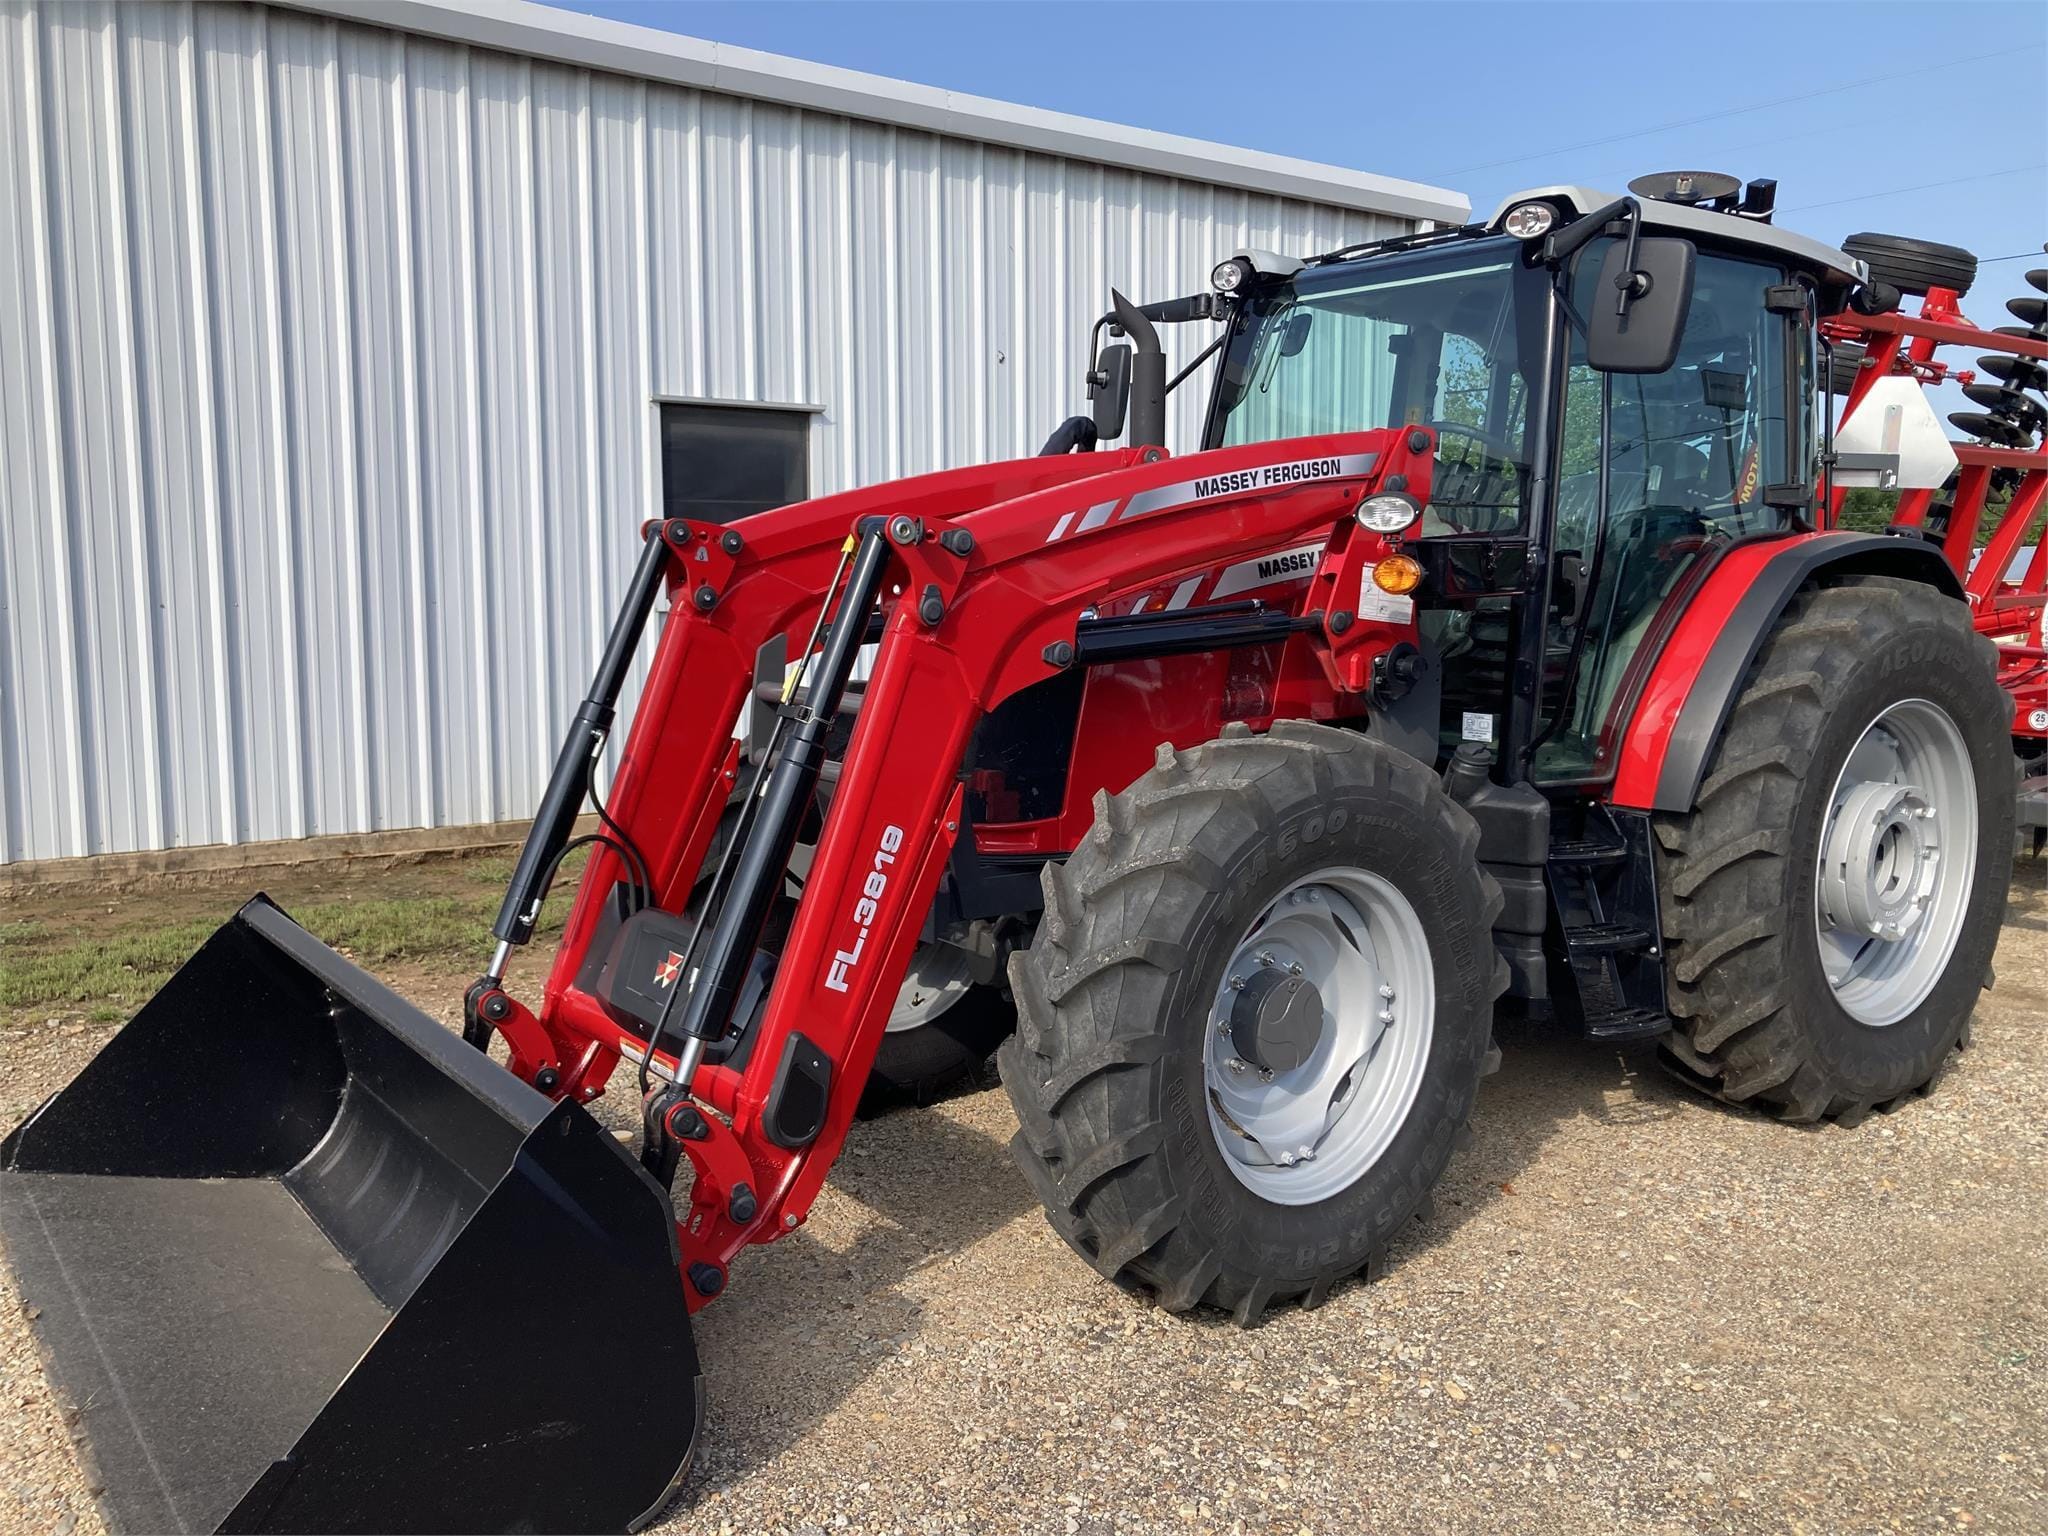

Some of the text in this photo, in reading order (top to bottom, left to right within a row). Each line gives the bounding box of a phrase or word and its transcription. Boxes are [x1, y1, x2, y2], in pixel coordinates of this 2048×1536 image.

[1195, 458, 1341, 498] MASSEY FERGUSON
[1257, 551, 1315, 579] MASSEY
[2035, 713, 2046, 723] 25
[824, 824, 904, 993] FL.3819
